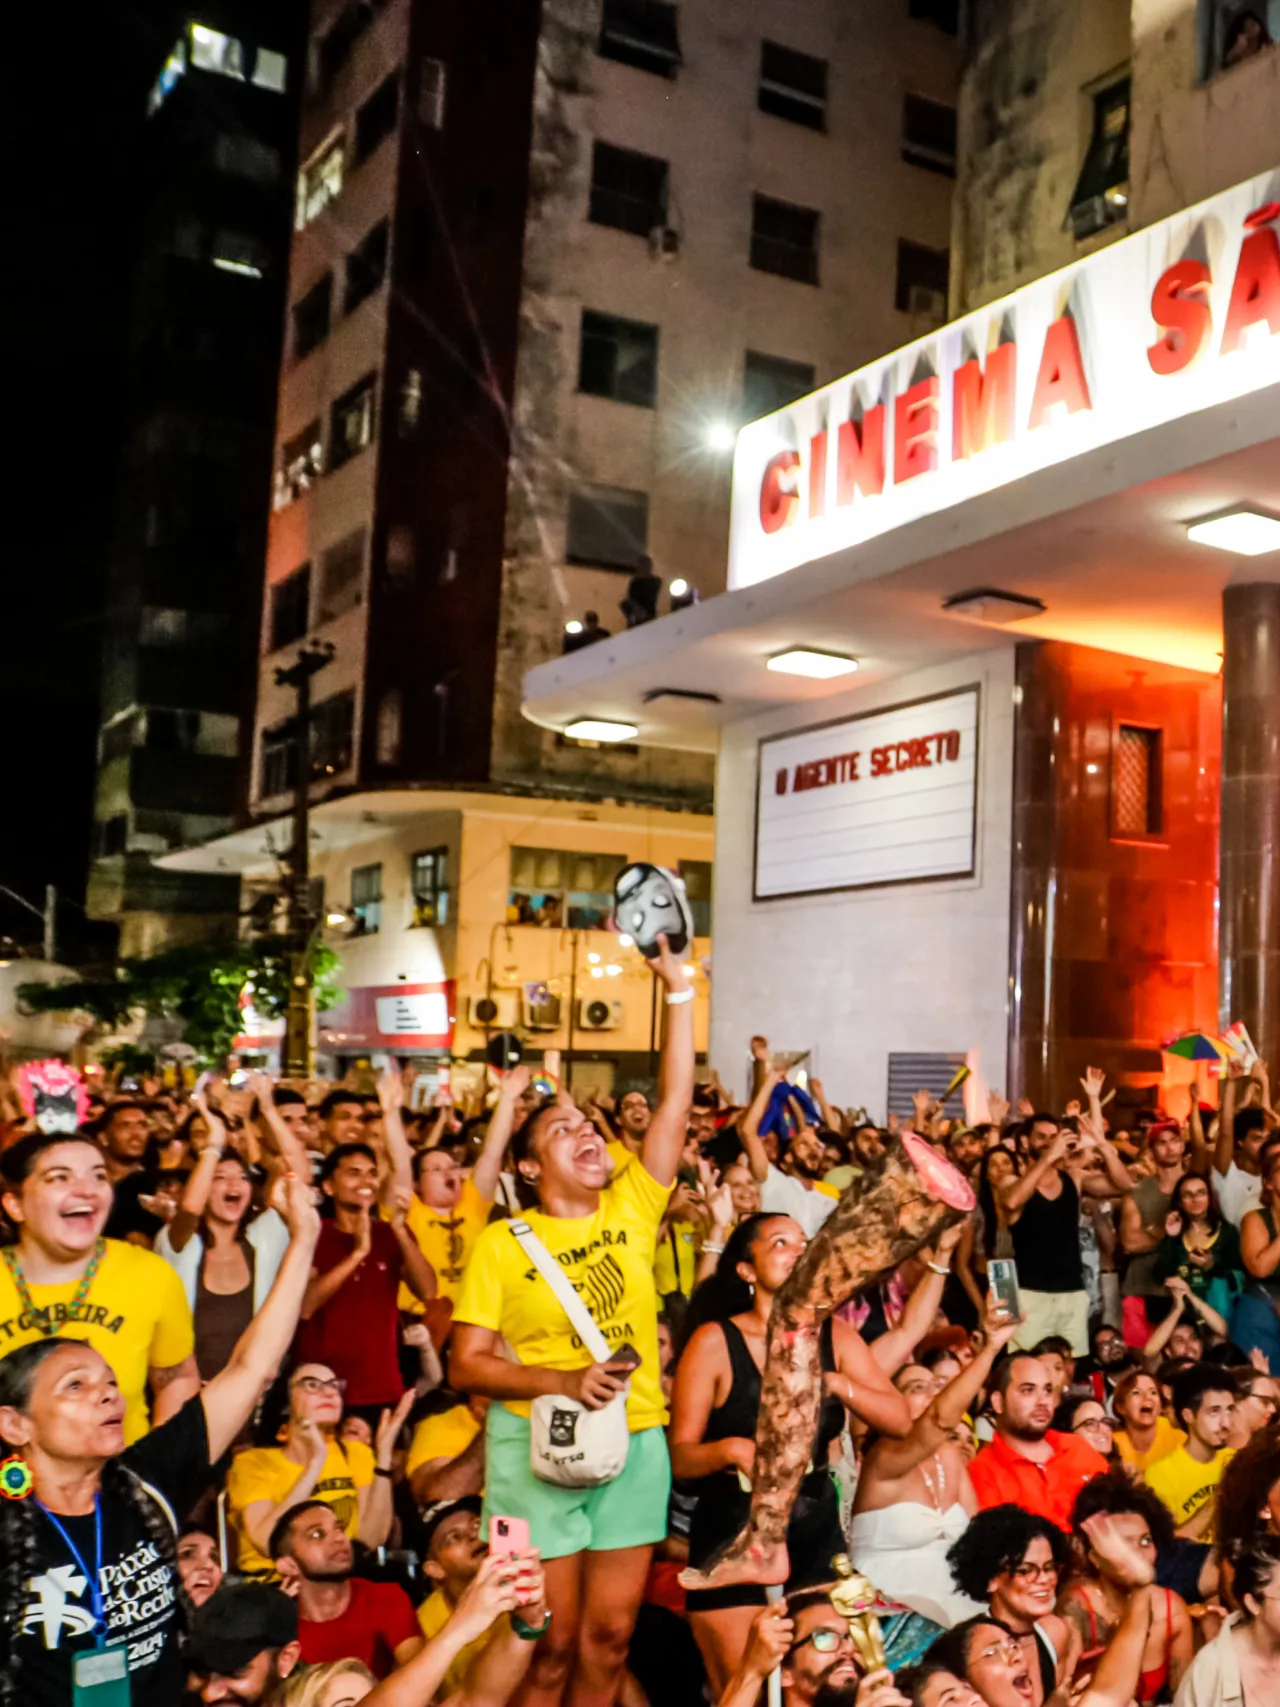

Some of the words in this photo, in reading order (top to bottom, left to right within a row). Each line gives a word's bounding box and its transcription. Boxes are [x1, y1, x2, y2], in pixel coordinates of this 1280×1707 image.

[759, 313, 1093, 534] CINEMA
[775, 767, 788, 796] O
[792, 750, 861, 793] AGENTE
[870, 729, 961, 778] SECRETO
